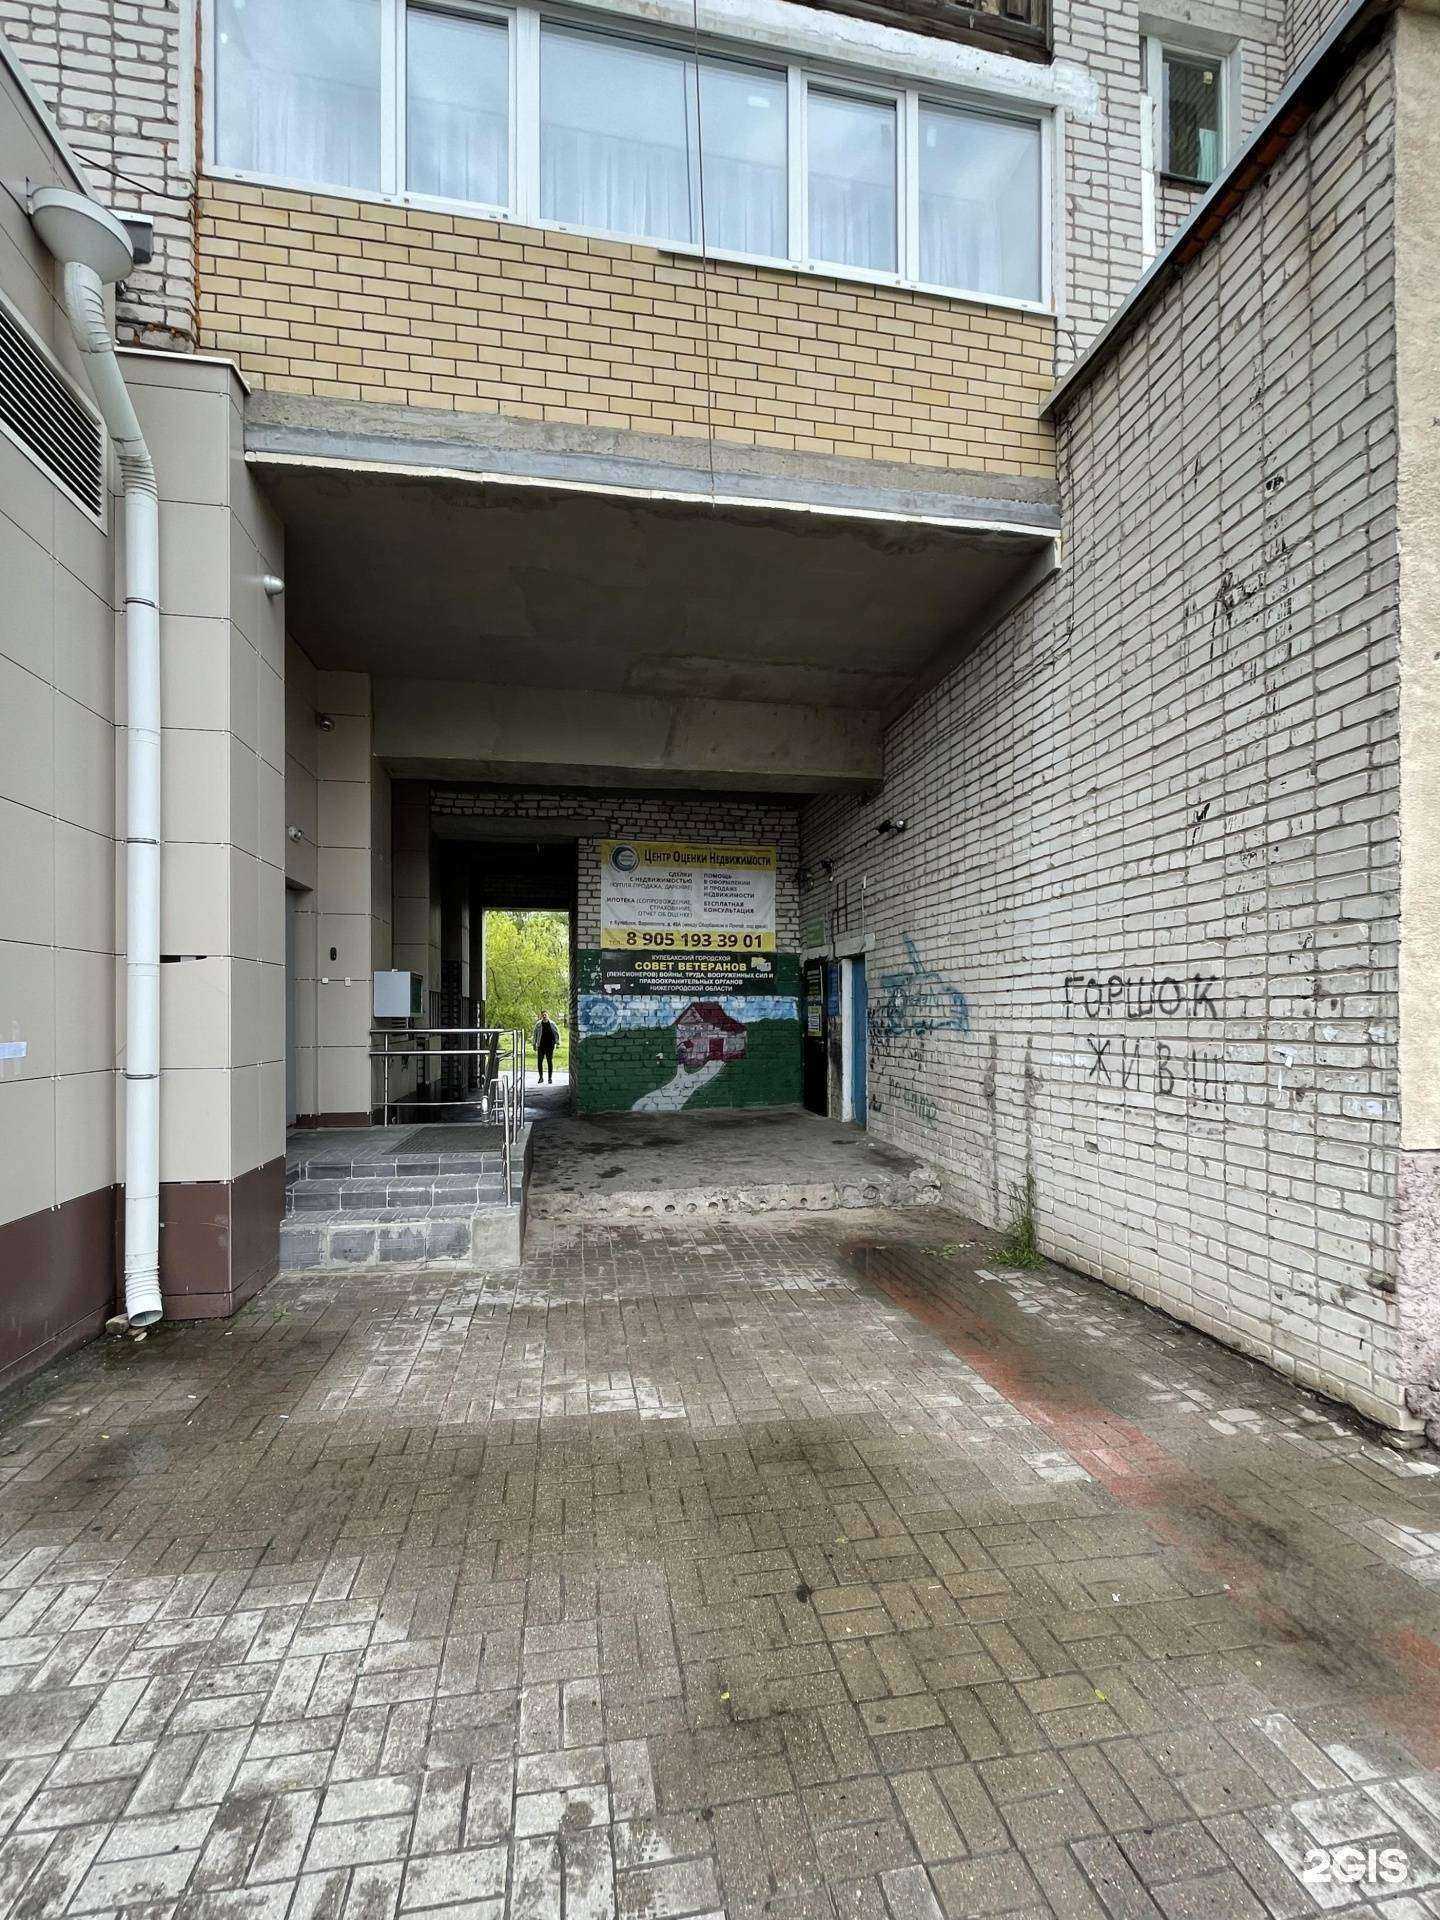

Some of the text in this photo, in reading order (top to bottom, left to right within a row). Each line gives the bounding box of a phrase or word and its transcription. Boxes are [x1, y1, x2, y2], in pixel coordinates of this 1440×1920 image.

[703, 872, 732, 880] ПОМОЩЬ
[703, 907, 754, 915] КОНСУЛЬТАЦИЯ
[627, 931, 637, 946] 8
[642, 932, 675, 947] 905
[681, 932, 712, 948] 193
[717, 933, 738, 948] 39
[743, 934, 762, 949] 01
[695, 955, 731, 963] ГОРОДСКОЙ
[635, 961, 747, 972] СОВЕТ ВЕТЕРАНОВ
[1064, 974, 1218, 1020] ГОРШОК
